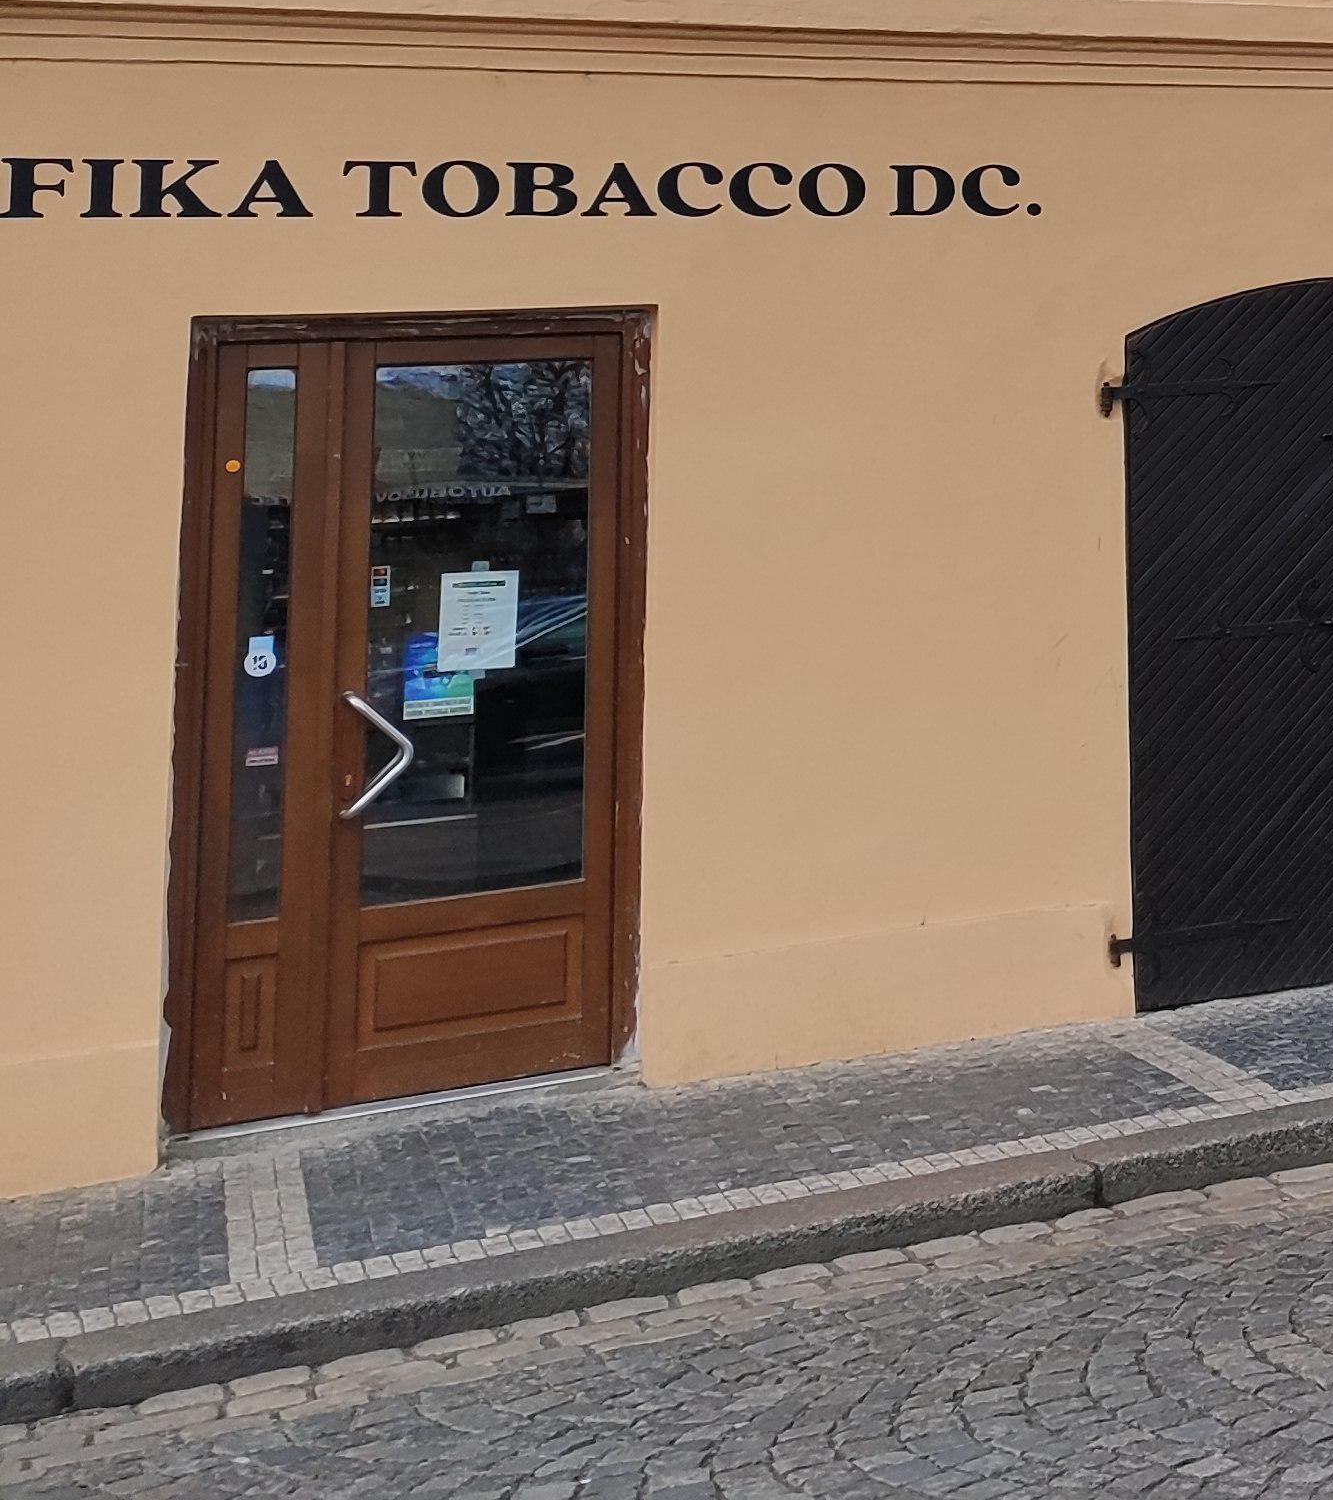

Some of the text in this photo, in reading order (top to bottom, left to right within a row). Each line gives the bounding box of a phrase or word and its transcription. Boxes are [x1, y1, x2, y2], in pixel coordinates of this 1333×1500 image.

[0, 158, 1043, 219] FIKA TOBACCO DC.
